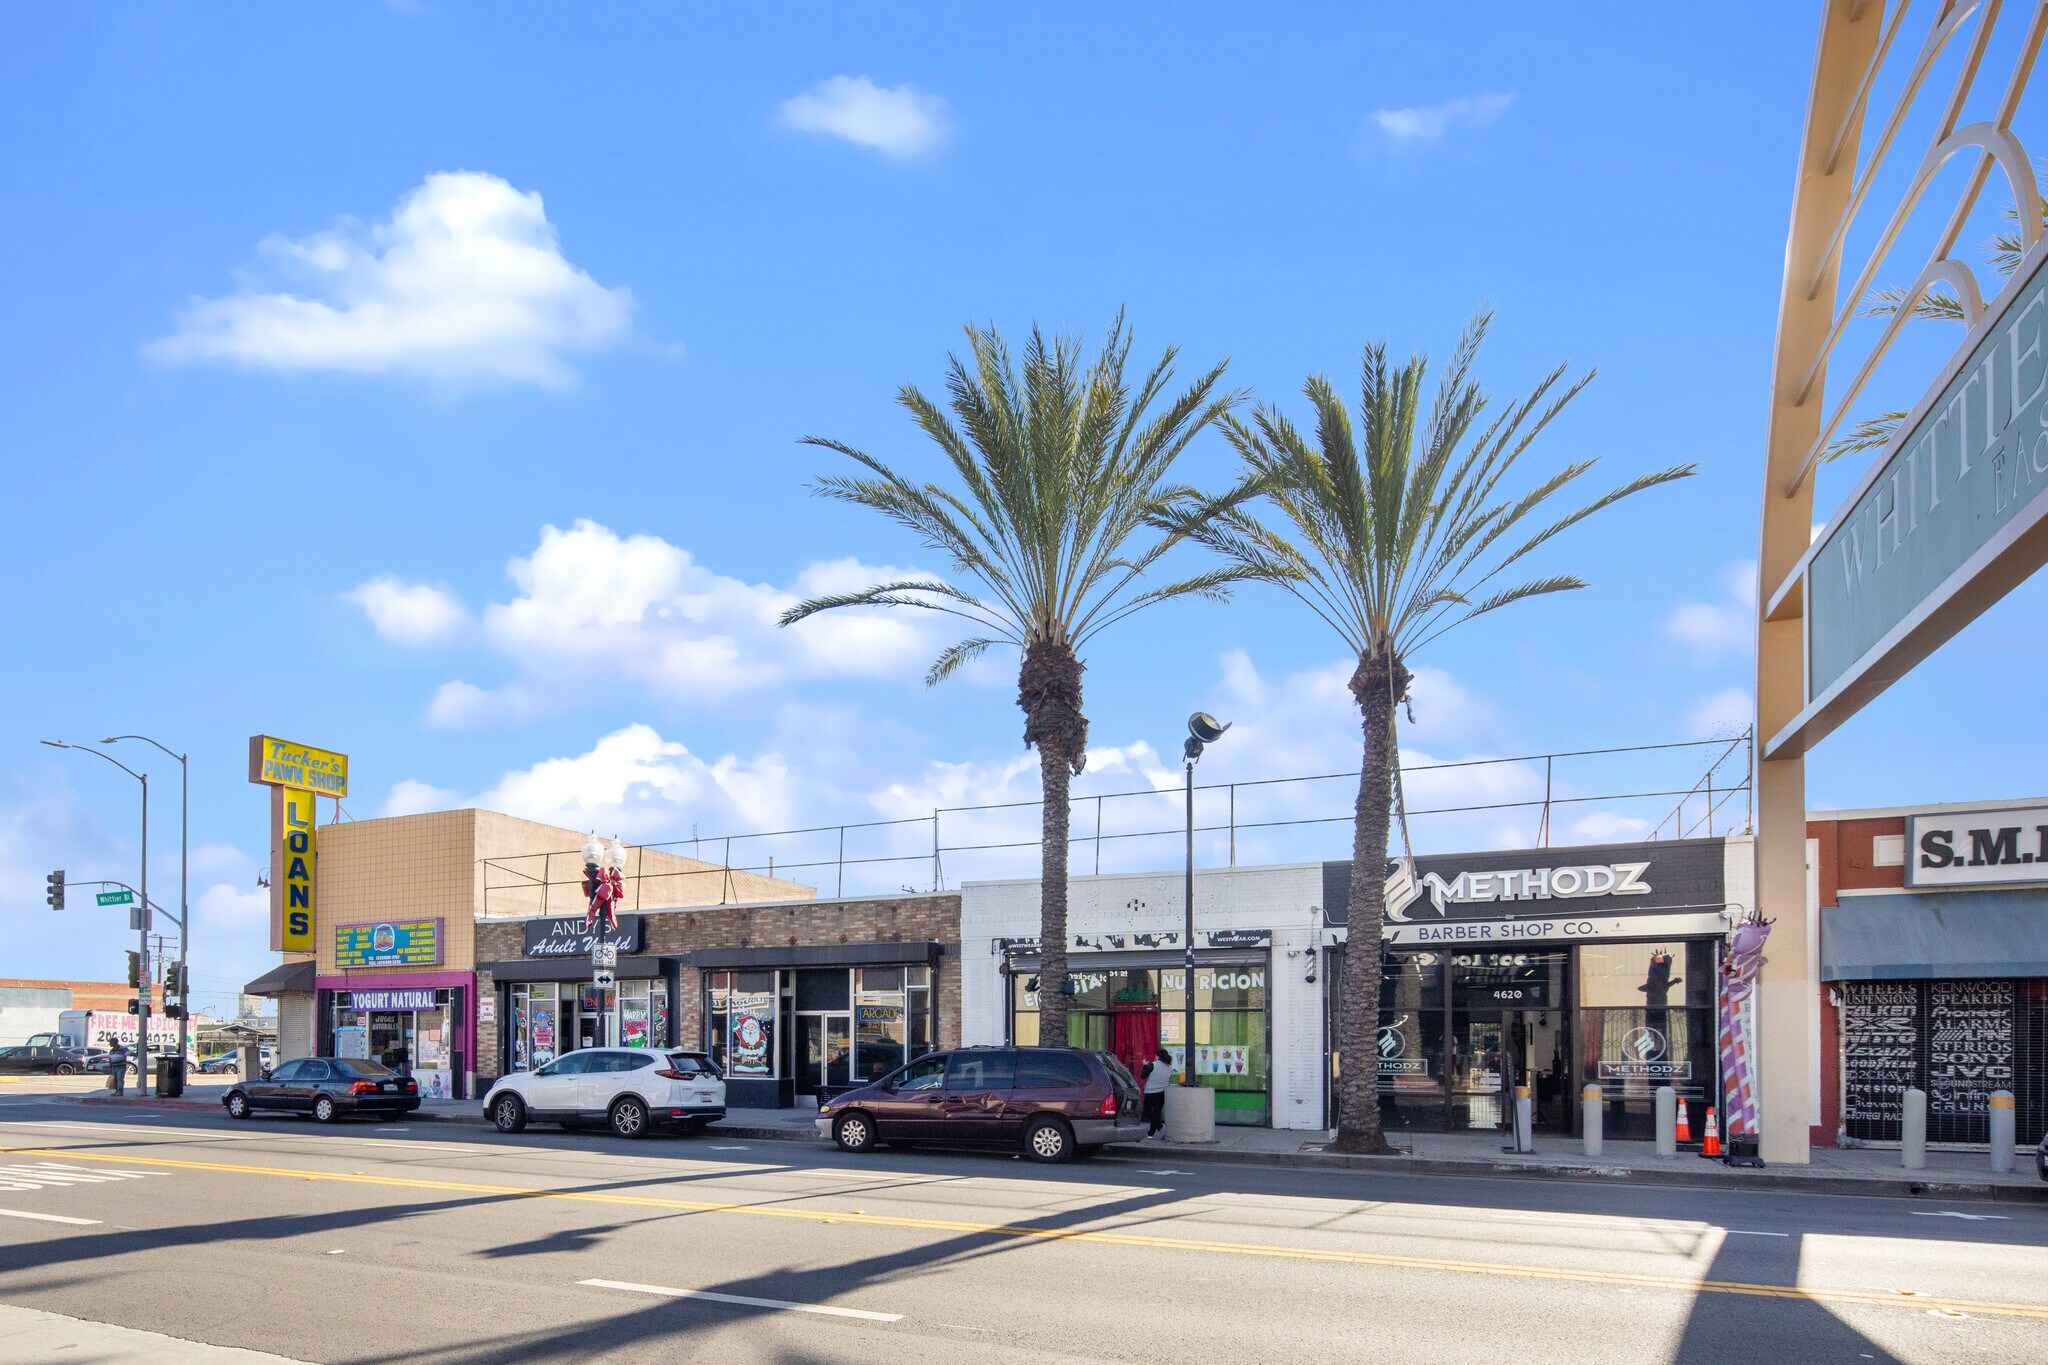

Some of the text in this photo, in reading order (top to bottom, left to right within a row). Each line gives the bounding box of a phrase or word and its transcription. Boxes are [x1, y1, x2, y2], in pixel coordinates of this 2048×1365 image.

[271, 741, 340, 773] Tucker's
[264, 759, 345, 792] PAWN SHOP
[288, 801, 310, 936] LOANS
[1424, 863, 1651, 917] METHODZ
[100, 895, 121, 903] Whittier
[551, 918, 612, 936] ANDYS
[1419, 922, 1599, 940] BARBER SHOP CO.
[530, 935, 632, 955] Adult Wld
[1161, 973, 1264, 990] NURICION
[1845, 985, 1917, 995] WHEELS
[1931, 982, 2012, 993] KENWOOD
[1493, 990, 1523, 999] 4620
[1846, 994, 1917, 1005] USPENSIONS
[1931, 994, 2012, 1005] SPEAKERS
[353, 992, 434, 1009] YOGURT NATURAL
[623, 1009, 646, 1020] HAPPY
[92, 1014, 118, 1029] FREE
[157, 1017, 195, 1031] PICKP
[1932, 1019, 2012, 1029] ALARMS
[1931, 1041, 2013, 1052] STEREOS
[1931, 1053, 2012, 1063] SONY
[1377, 1062, 1421, 1070] THODZ
[1606, 1065, 1683, 1073] METHODZ
[1931, 1065, 2012, 1077] JVC
[1954, 1089, 1990, 1101] infin
[1931, 1101, 1990, 1111] CRUN
